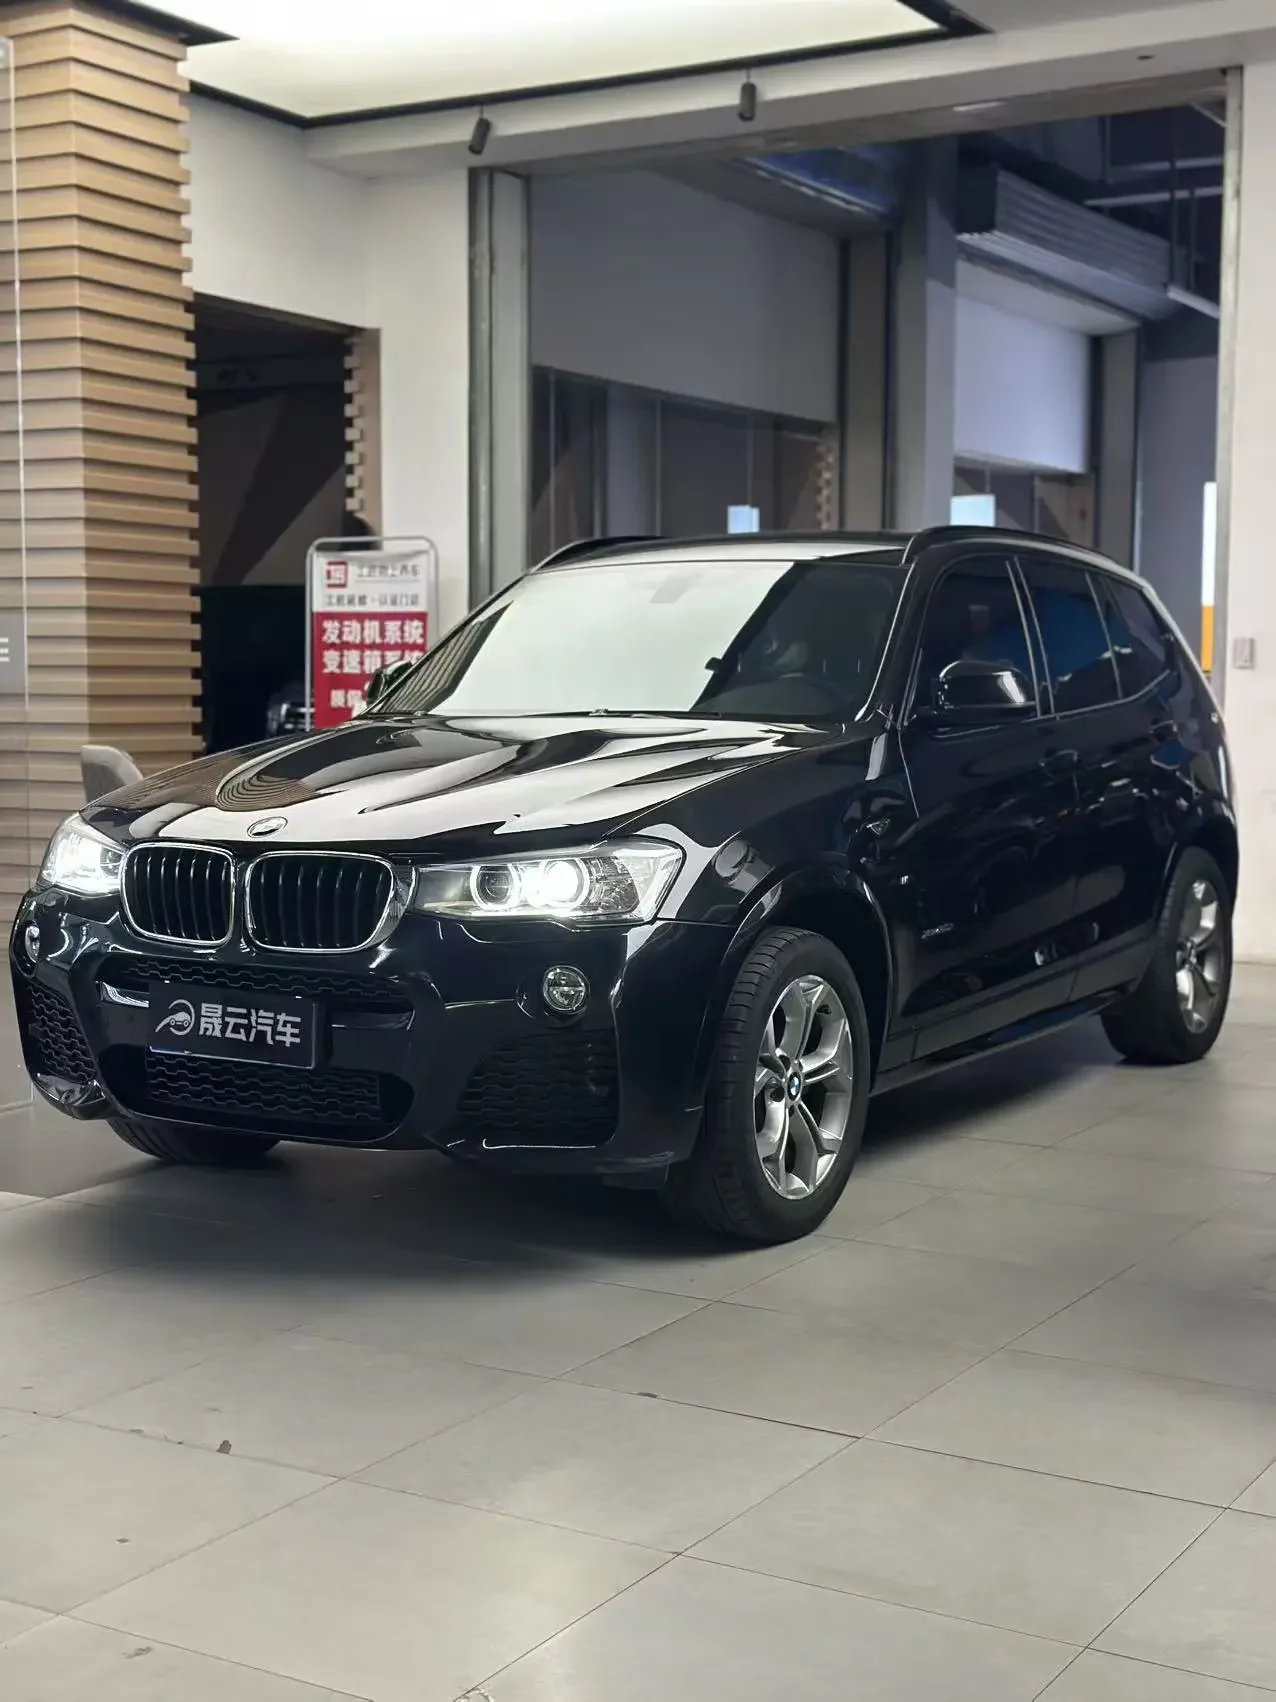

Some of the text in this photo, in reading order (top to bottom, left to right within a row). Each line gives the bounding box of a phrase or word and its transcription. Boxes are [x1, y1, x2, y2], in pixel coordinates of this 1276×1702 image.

[322, 619, 424, 644] 发动机系统
[199, 1003, 301, 1047] 晟云汽车
